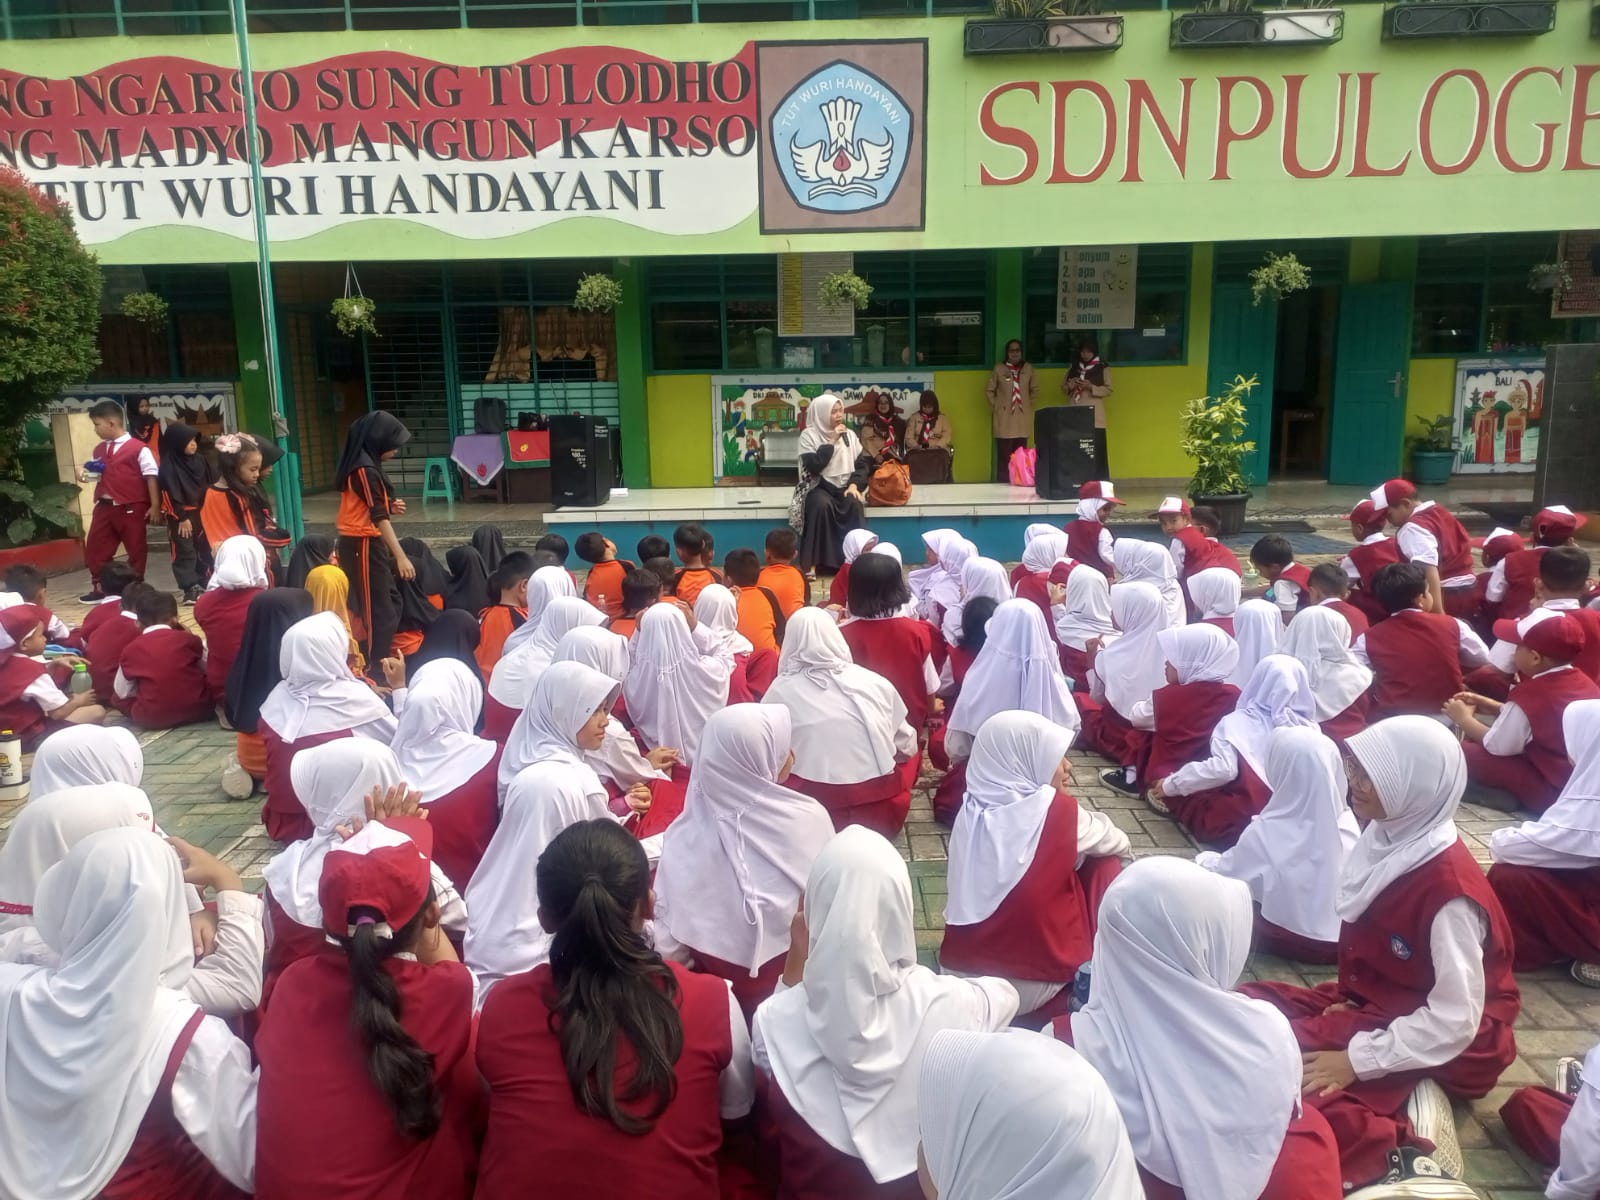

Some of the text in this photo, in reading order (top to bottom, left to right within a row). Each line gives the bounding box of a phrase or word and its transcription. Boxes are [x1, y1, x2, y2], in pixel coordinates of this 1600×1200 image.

[69, 70, 300, 117] NGARSO
[315, 65, 464, 112] SUNG
[479, 60, 751, 107] TULODHO
[781, 78, 901, 127] TUT WURI HANDAYANI
[72, 123, 273, 168] MADYO
[289, 117, 537, 164] MANGUN
[551, 114, 756, 159] KARSO
[977, 78, 1197, 186] SDN
[160, 176, 323, 219] WURI
[338, 169, 666, 215] HANDAYANI
[843, 390, 865, 400] JAWA
[1495, 376, 1513, 387] BALI
